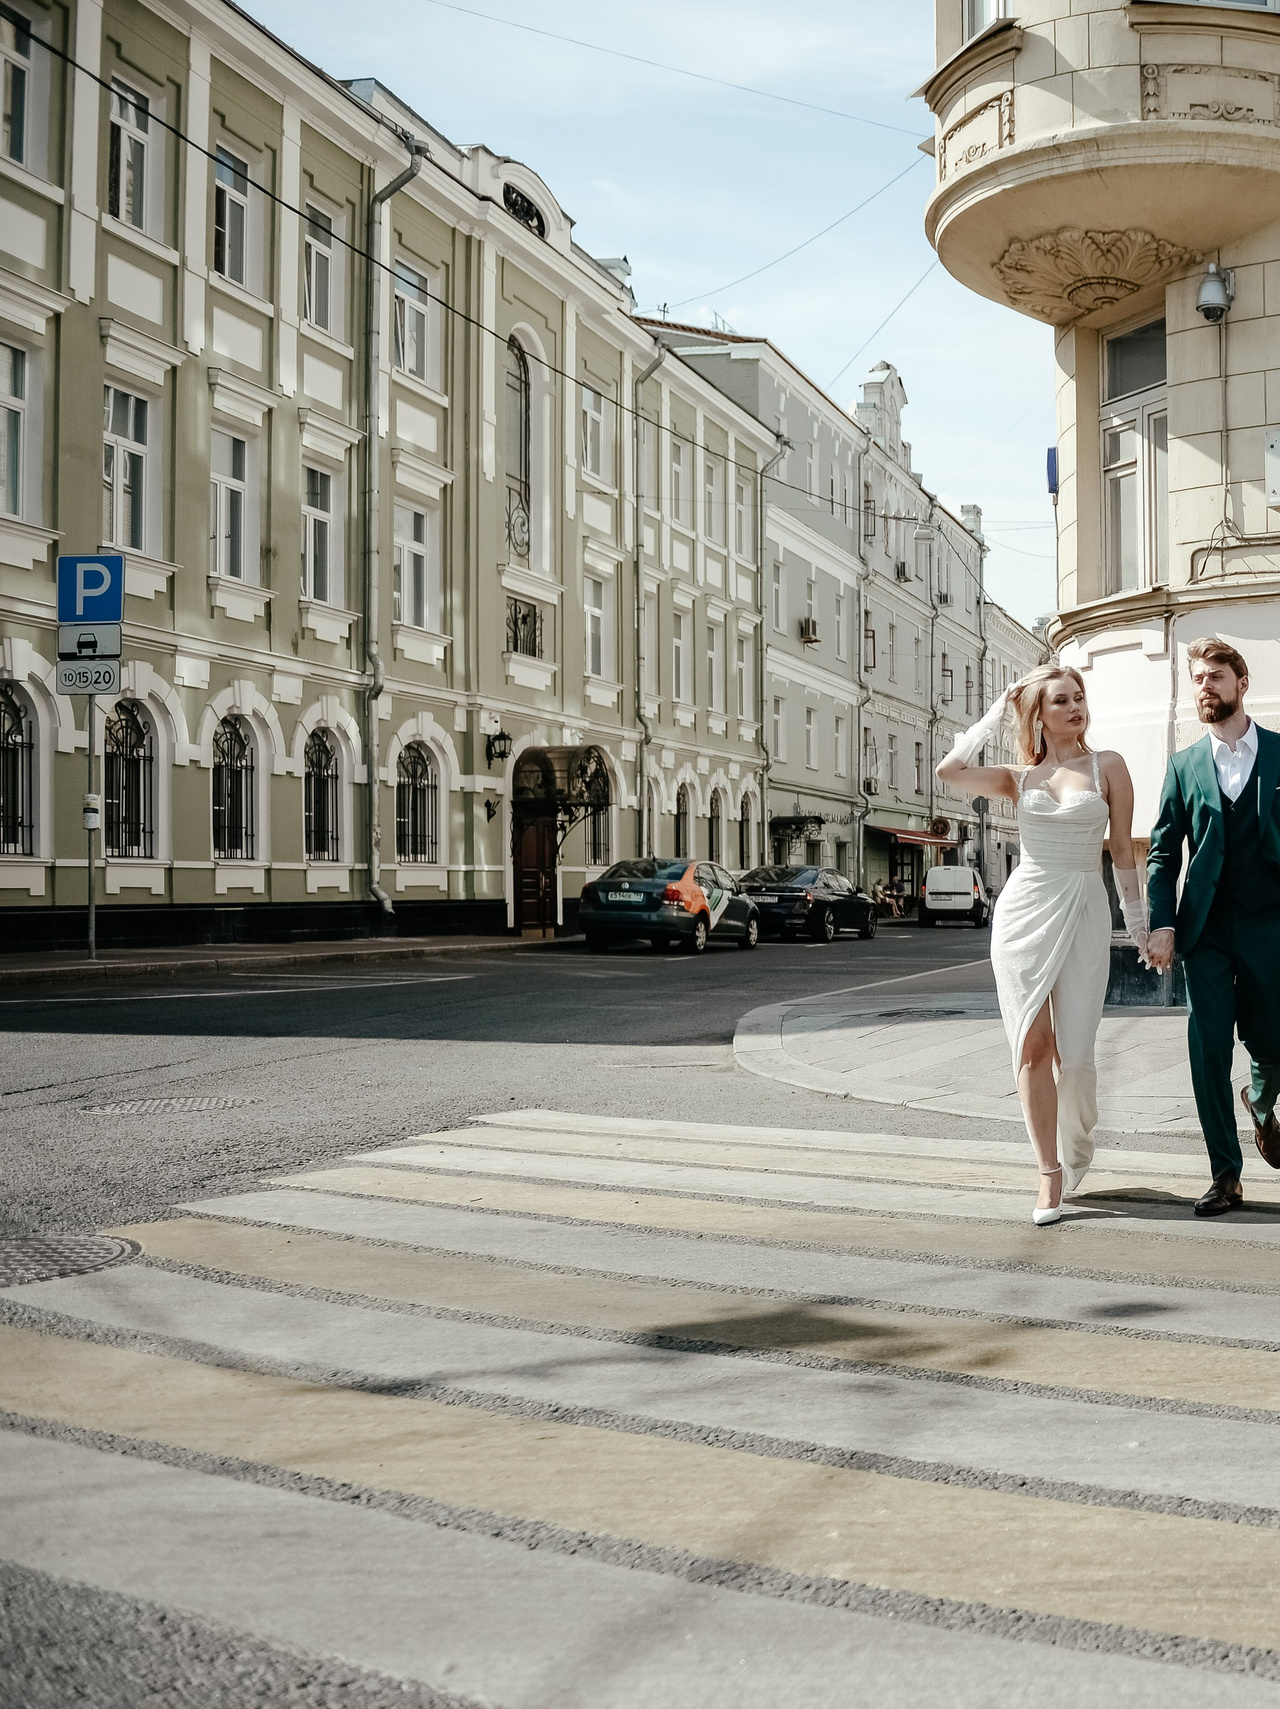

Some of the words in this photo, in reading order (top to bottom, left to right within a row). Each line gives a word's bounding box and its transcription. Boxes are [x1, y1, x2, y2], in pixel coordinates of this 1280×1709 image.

[75, 562, 112, 615] P
[63, 673, 74, 682] 10
[77, 671, 89, 683] 15
[93, 670, 112, 685] 20
